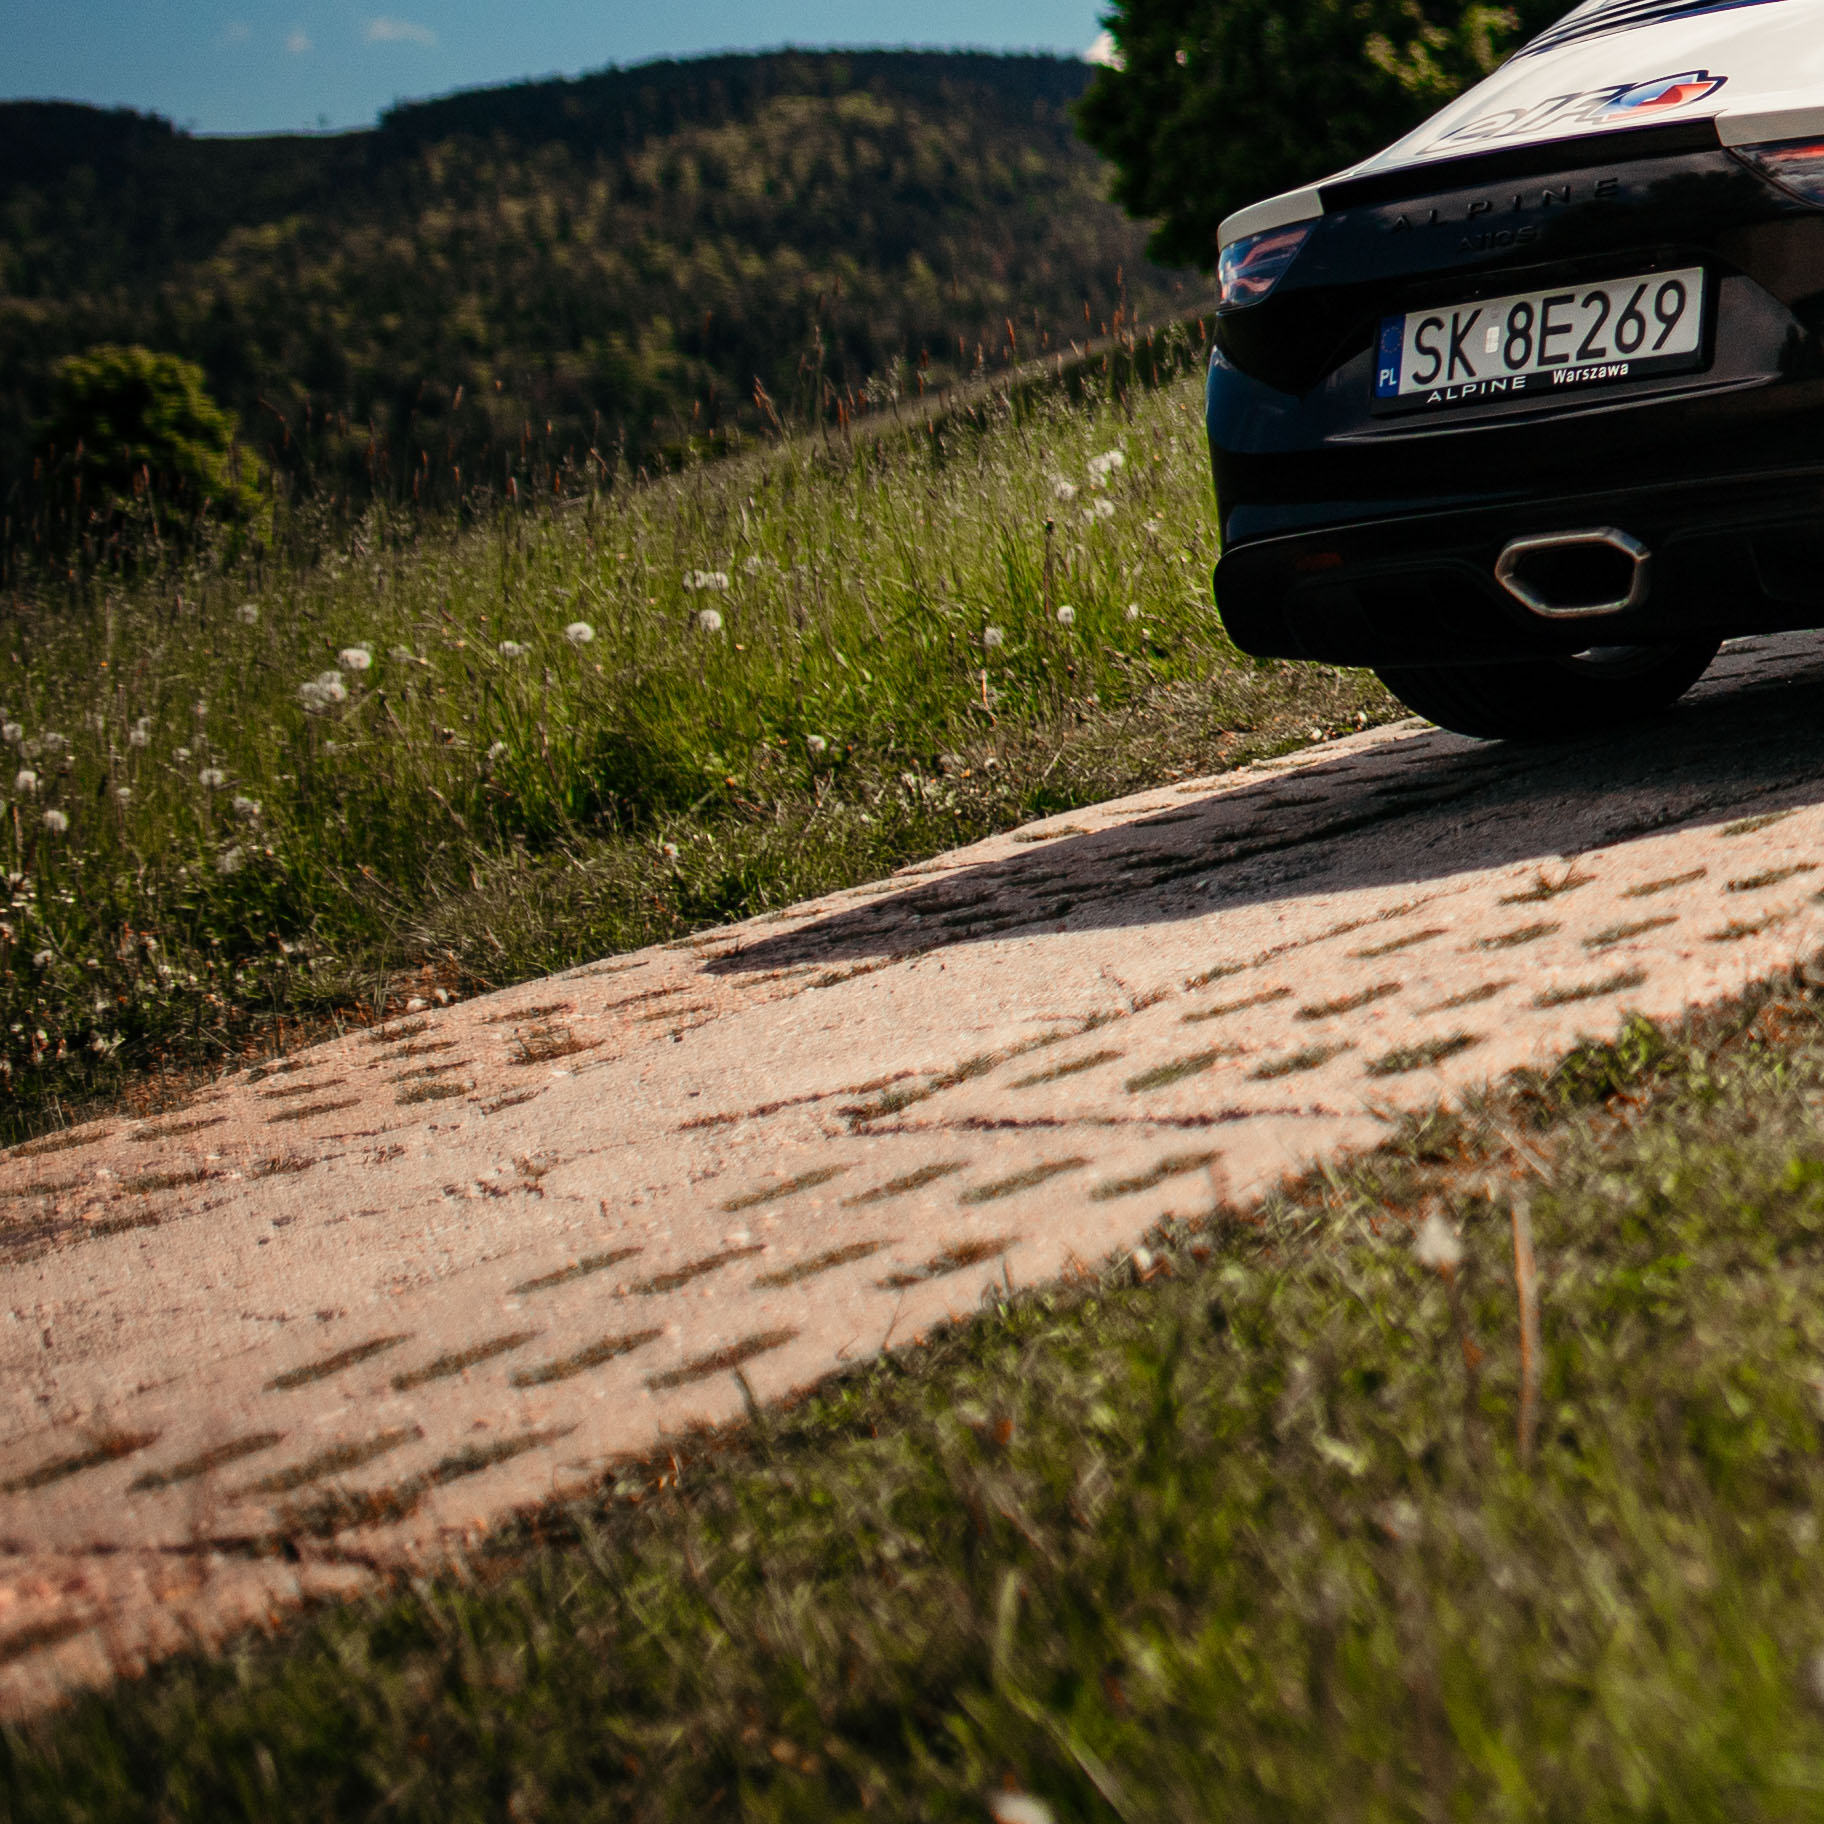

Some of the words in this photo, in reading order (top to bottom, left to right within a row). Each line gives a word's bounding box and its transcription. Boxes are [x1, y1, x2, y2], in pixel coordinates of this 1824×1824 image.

[1393, 177, 1619, 233] ALPINE
[1412, 308, 1482, 386] SK
[1503, 279, 1687, 371] 8E269
[1379, 368, 1398, 388] PL
[1426, 375, 1527, 404] ALPINE
[1552, 361, 1629, 385] Warszawa
